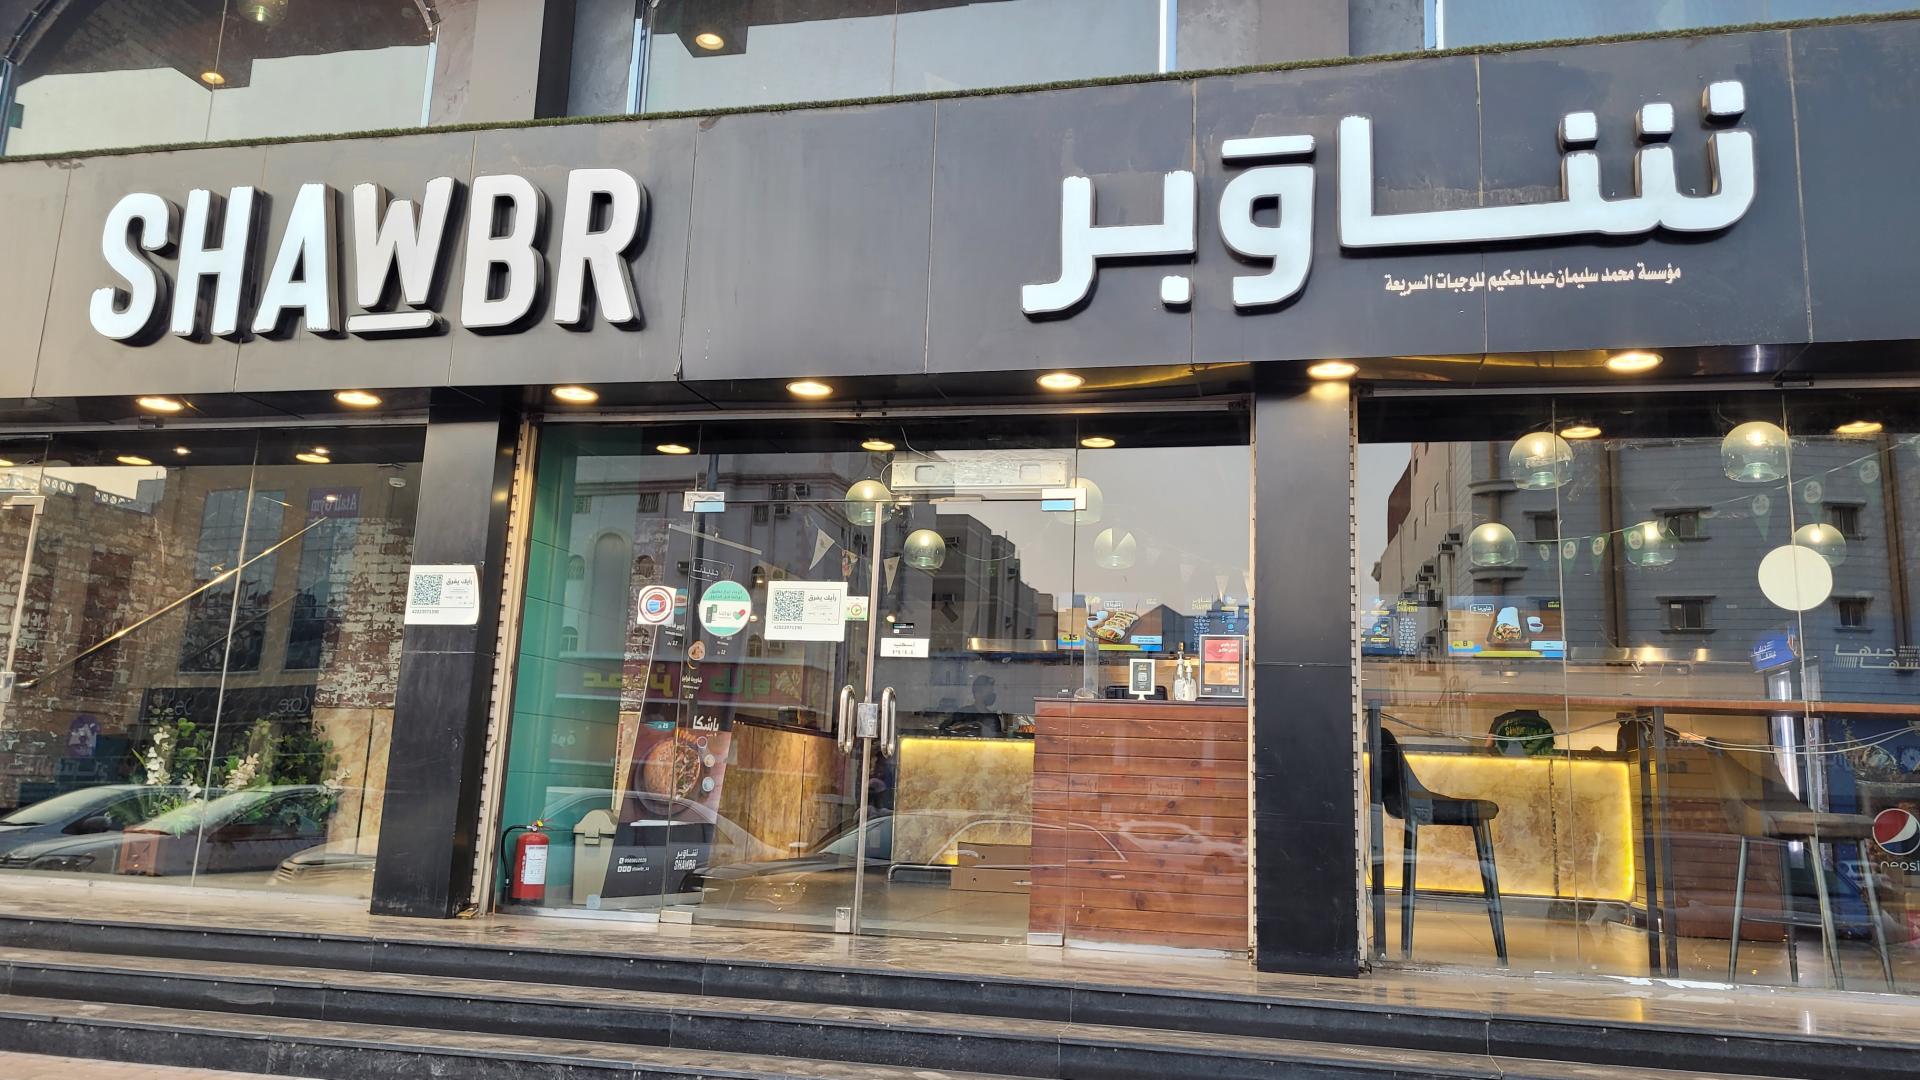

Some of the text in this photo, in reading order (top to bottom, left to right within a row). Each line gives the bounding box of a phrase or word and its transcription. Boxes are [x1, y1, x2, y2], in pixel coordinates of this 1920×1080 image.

[89, 168, 645, 342] SHAWBR
[1435, 271, 1485, 292] للوجبات
[1556, 266, 1599, 289] سليمان
[1601, 268, 1635, 282] محمد
[1637, 261, 1681, 284] مؤسسة
[1384, 273, 1433, 297] السريعة
[673, 859, 697, 871] SHAWBR
